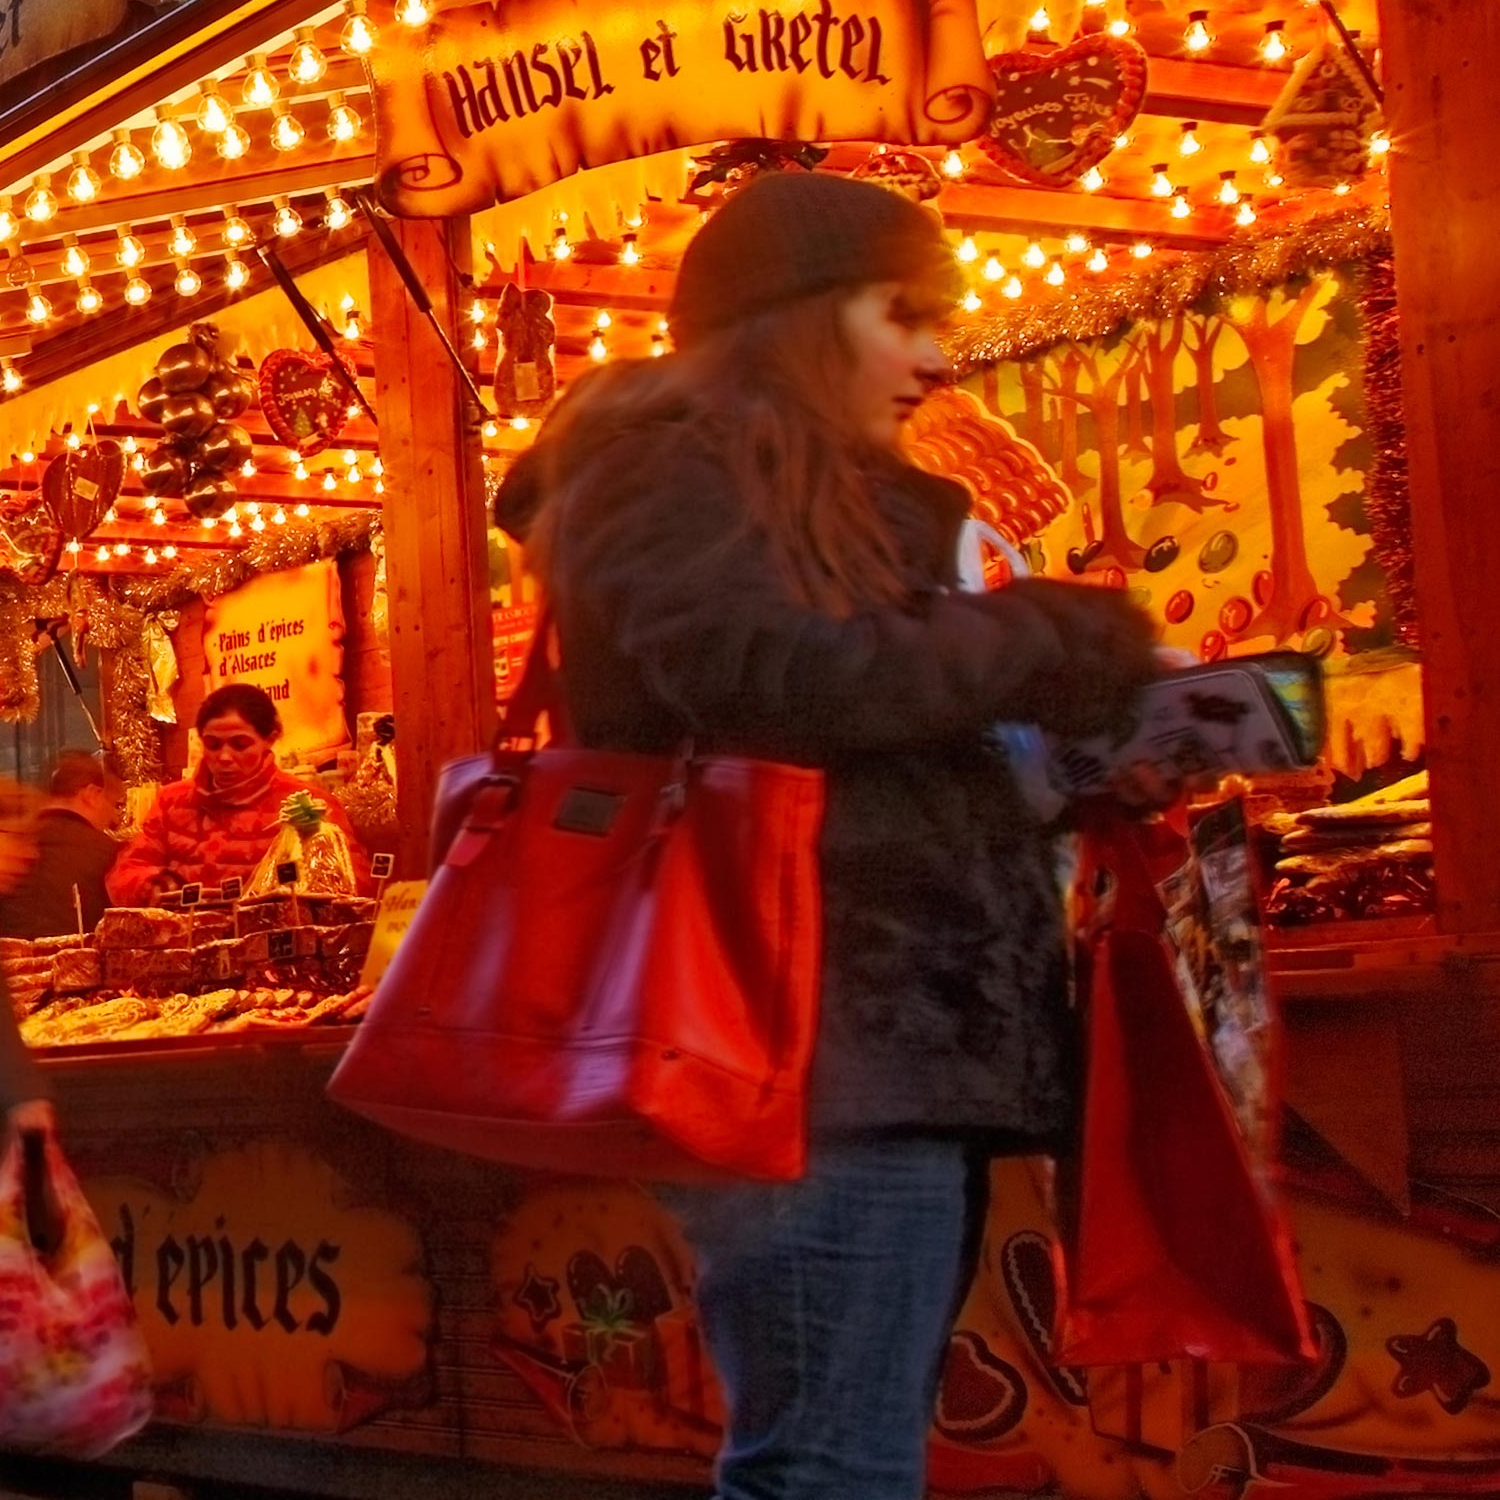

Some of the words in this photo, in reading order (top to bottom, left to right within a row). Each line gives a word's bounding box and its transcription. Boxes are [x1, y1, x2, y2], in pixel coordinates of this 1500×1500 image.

[639, 19, 681, 81] et
[219, 630, 250, 652] Pains
[110, 1202, 342, 1337] d'épices
